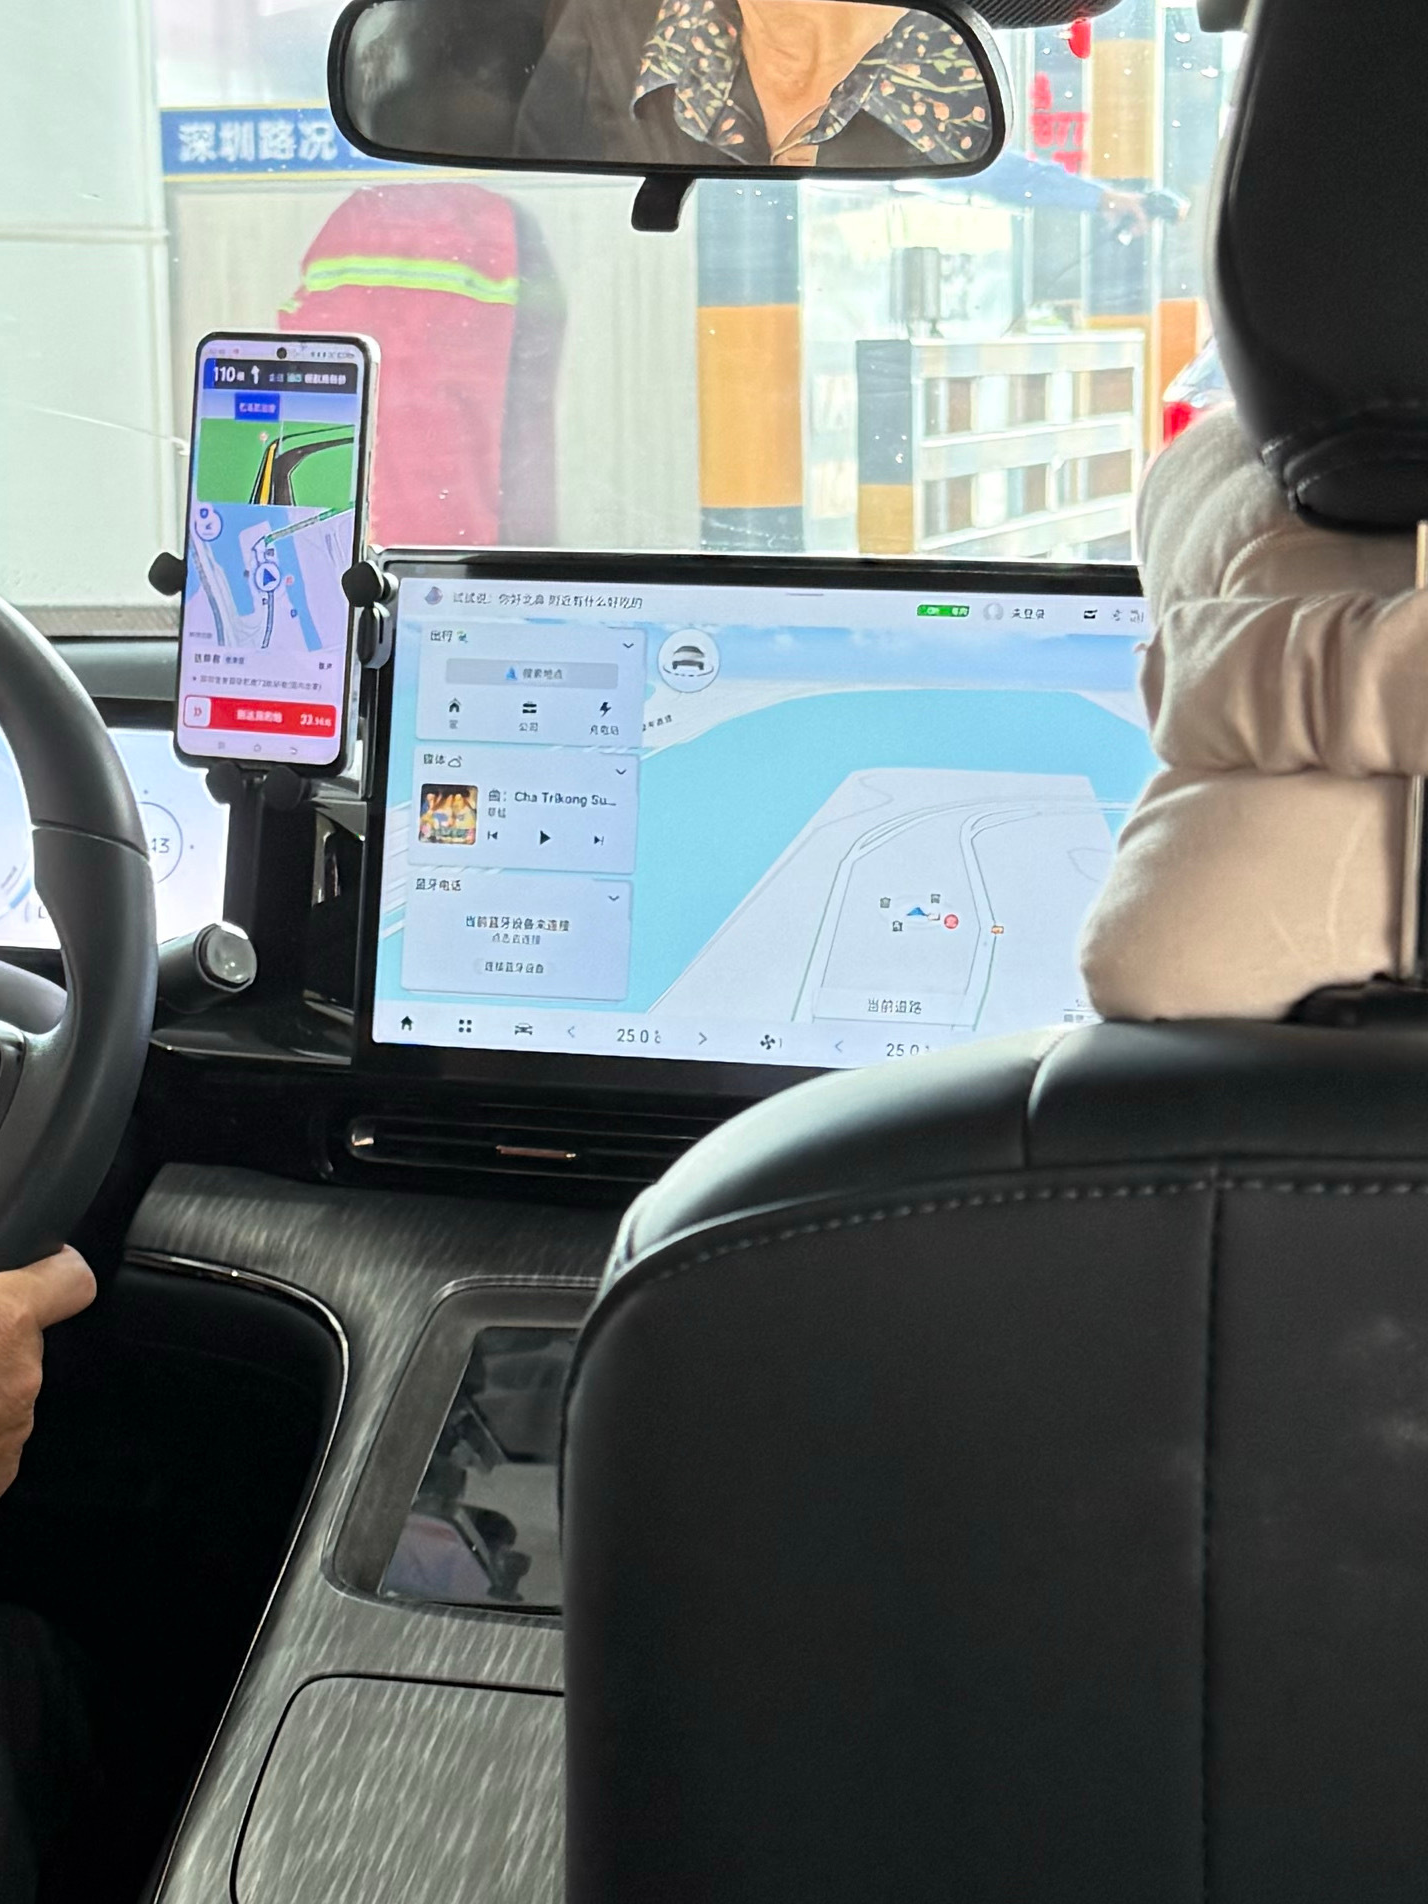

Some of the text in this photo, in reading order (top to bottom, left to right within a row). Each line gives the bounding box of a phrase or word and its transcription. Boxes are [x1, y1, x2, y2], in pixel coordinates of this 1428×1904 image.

[178, 119, 338, 163] 深圳路况
[430, 630, 452, 643] 出行
[514, 791, 538, 803] Cha
